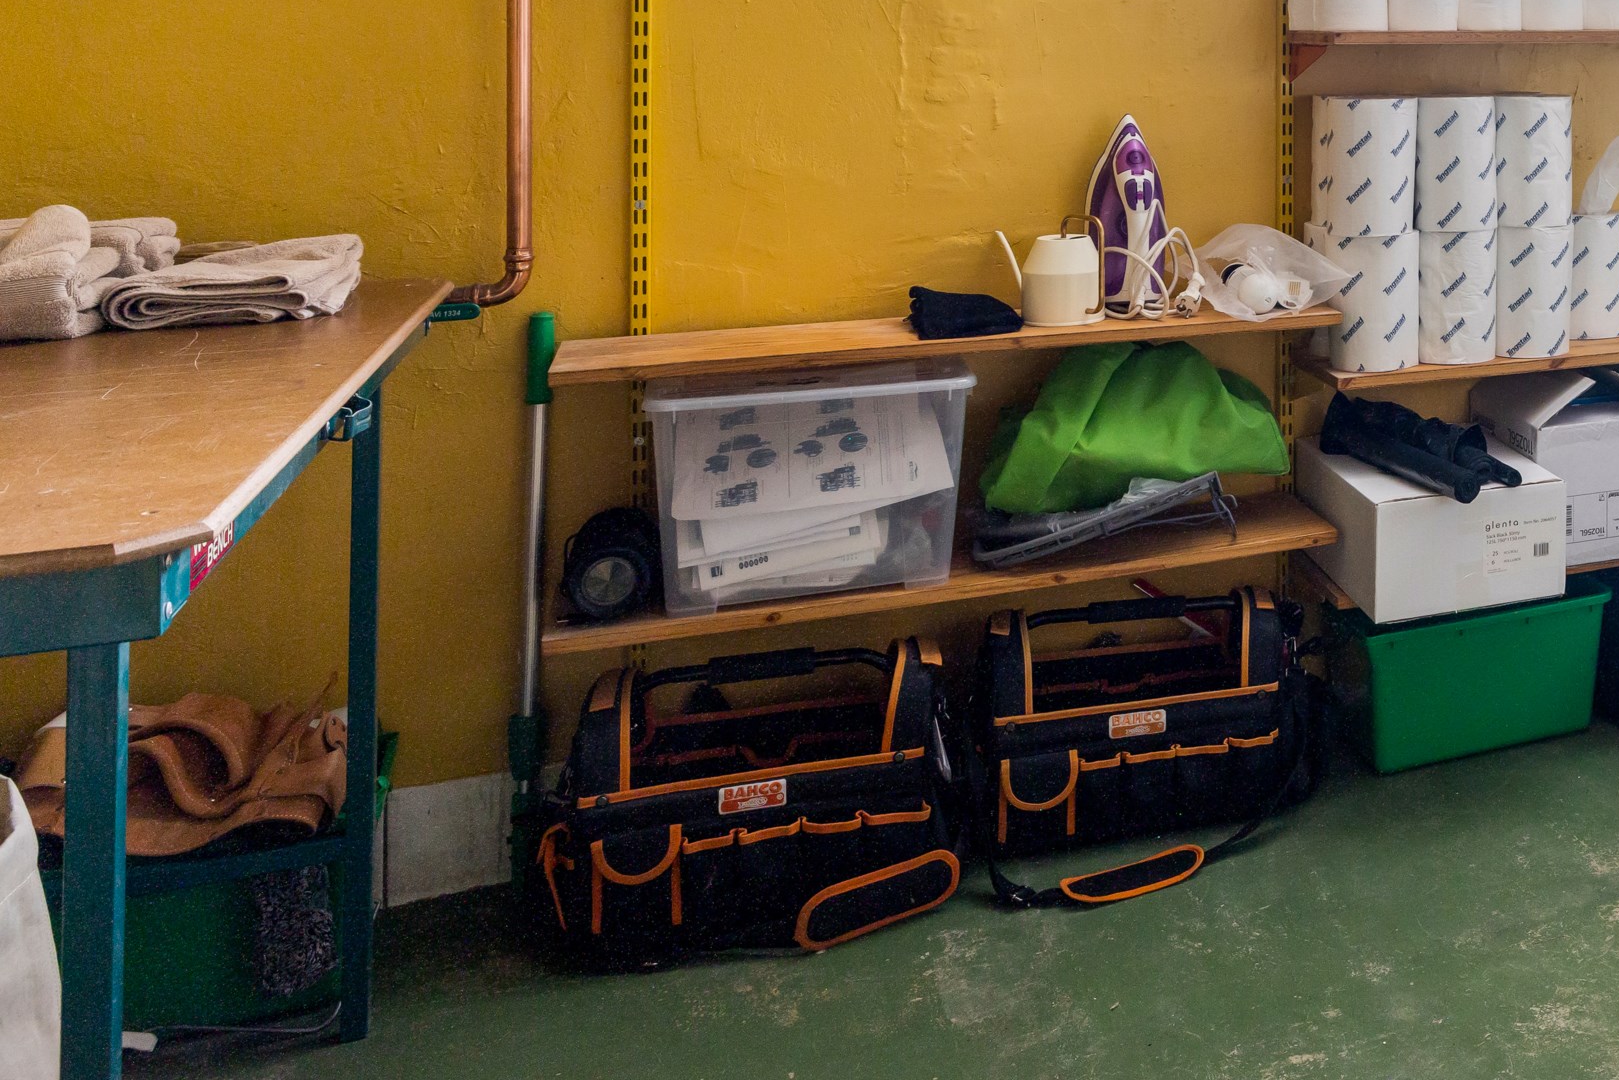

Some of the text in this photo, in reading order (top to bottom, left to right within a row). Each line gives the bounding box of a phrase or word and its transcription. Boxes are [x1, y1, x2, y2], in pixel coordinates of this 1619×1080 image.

[1434, 110, 1459, 137] Tingstad
[1523, 113, 1548, 139] Tingstad
[1346, 130, 1372, 158] Tingstad
[1390, 129, 1410, 157] Tingstad
[1436, 156, 1461, 183] Tingstad
[1524, 157, 1548, 184] Tingstad
[1346, 177, 1372, 204] Tingstad
[1390, 176, 1408, 204] Tingstad
[1437, 202, 1462, 229] Tingstad
[1524, 202, 1549, 228] Tingstad
[1509, 243, 1535, 268] Tingstad
[1383, 267, 1407, 296] Tingstad
[1441, 272, 1467, 298] Tingstad
[1507, 287, 1533, 313] Tingstad
[1549, 286, 1567, 312] Tingstad
[1341, 316, 1364, 344] Tingstad
[1384, 313, 1406, 342] Tingstad
[1440, 317, 1466, 344] Tingstad
[1506, 332, 1531, 358] Tingstad
[1485, 520, 1518, 532] glenta
[1580, 526, 1605, 536] 110256L
[207, 521, 234, 568] BENCH
[1111, 711, 1162, 726] BAHCO
[723, 781, 782, 800] BAHCO
